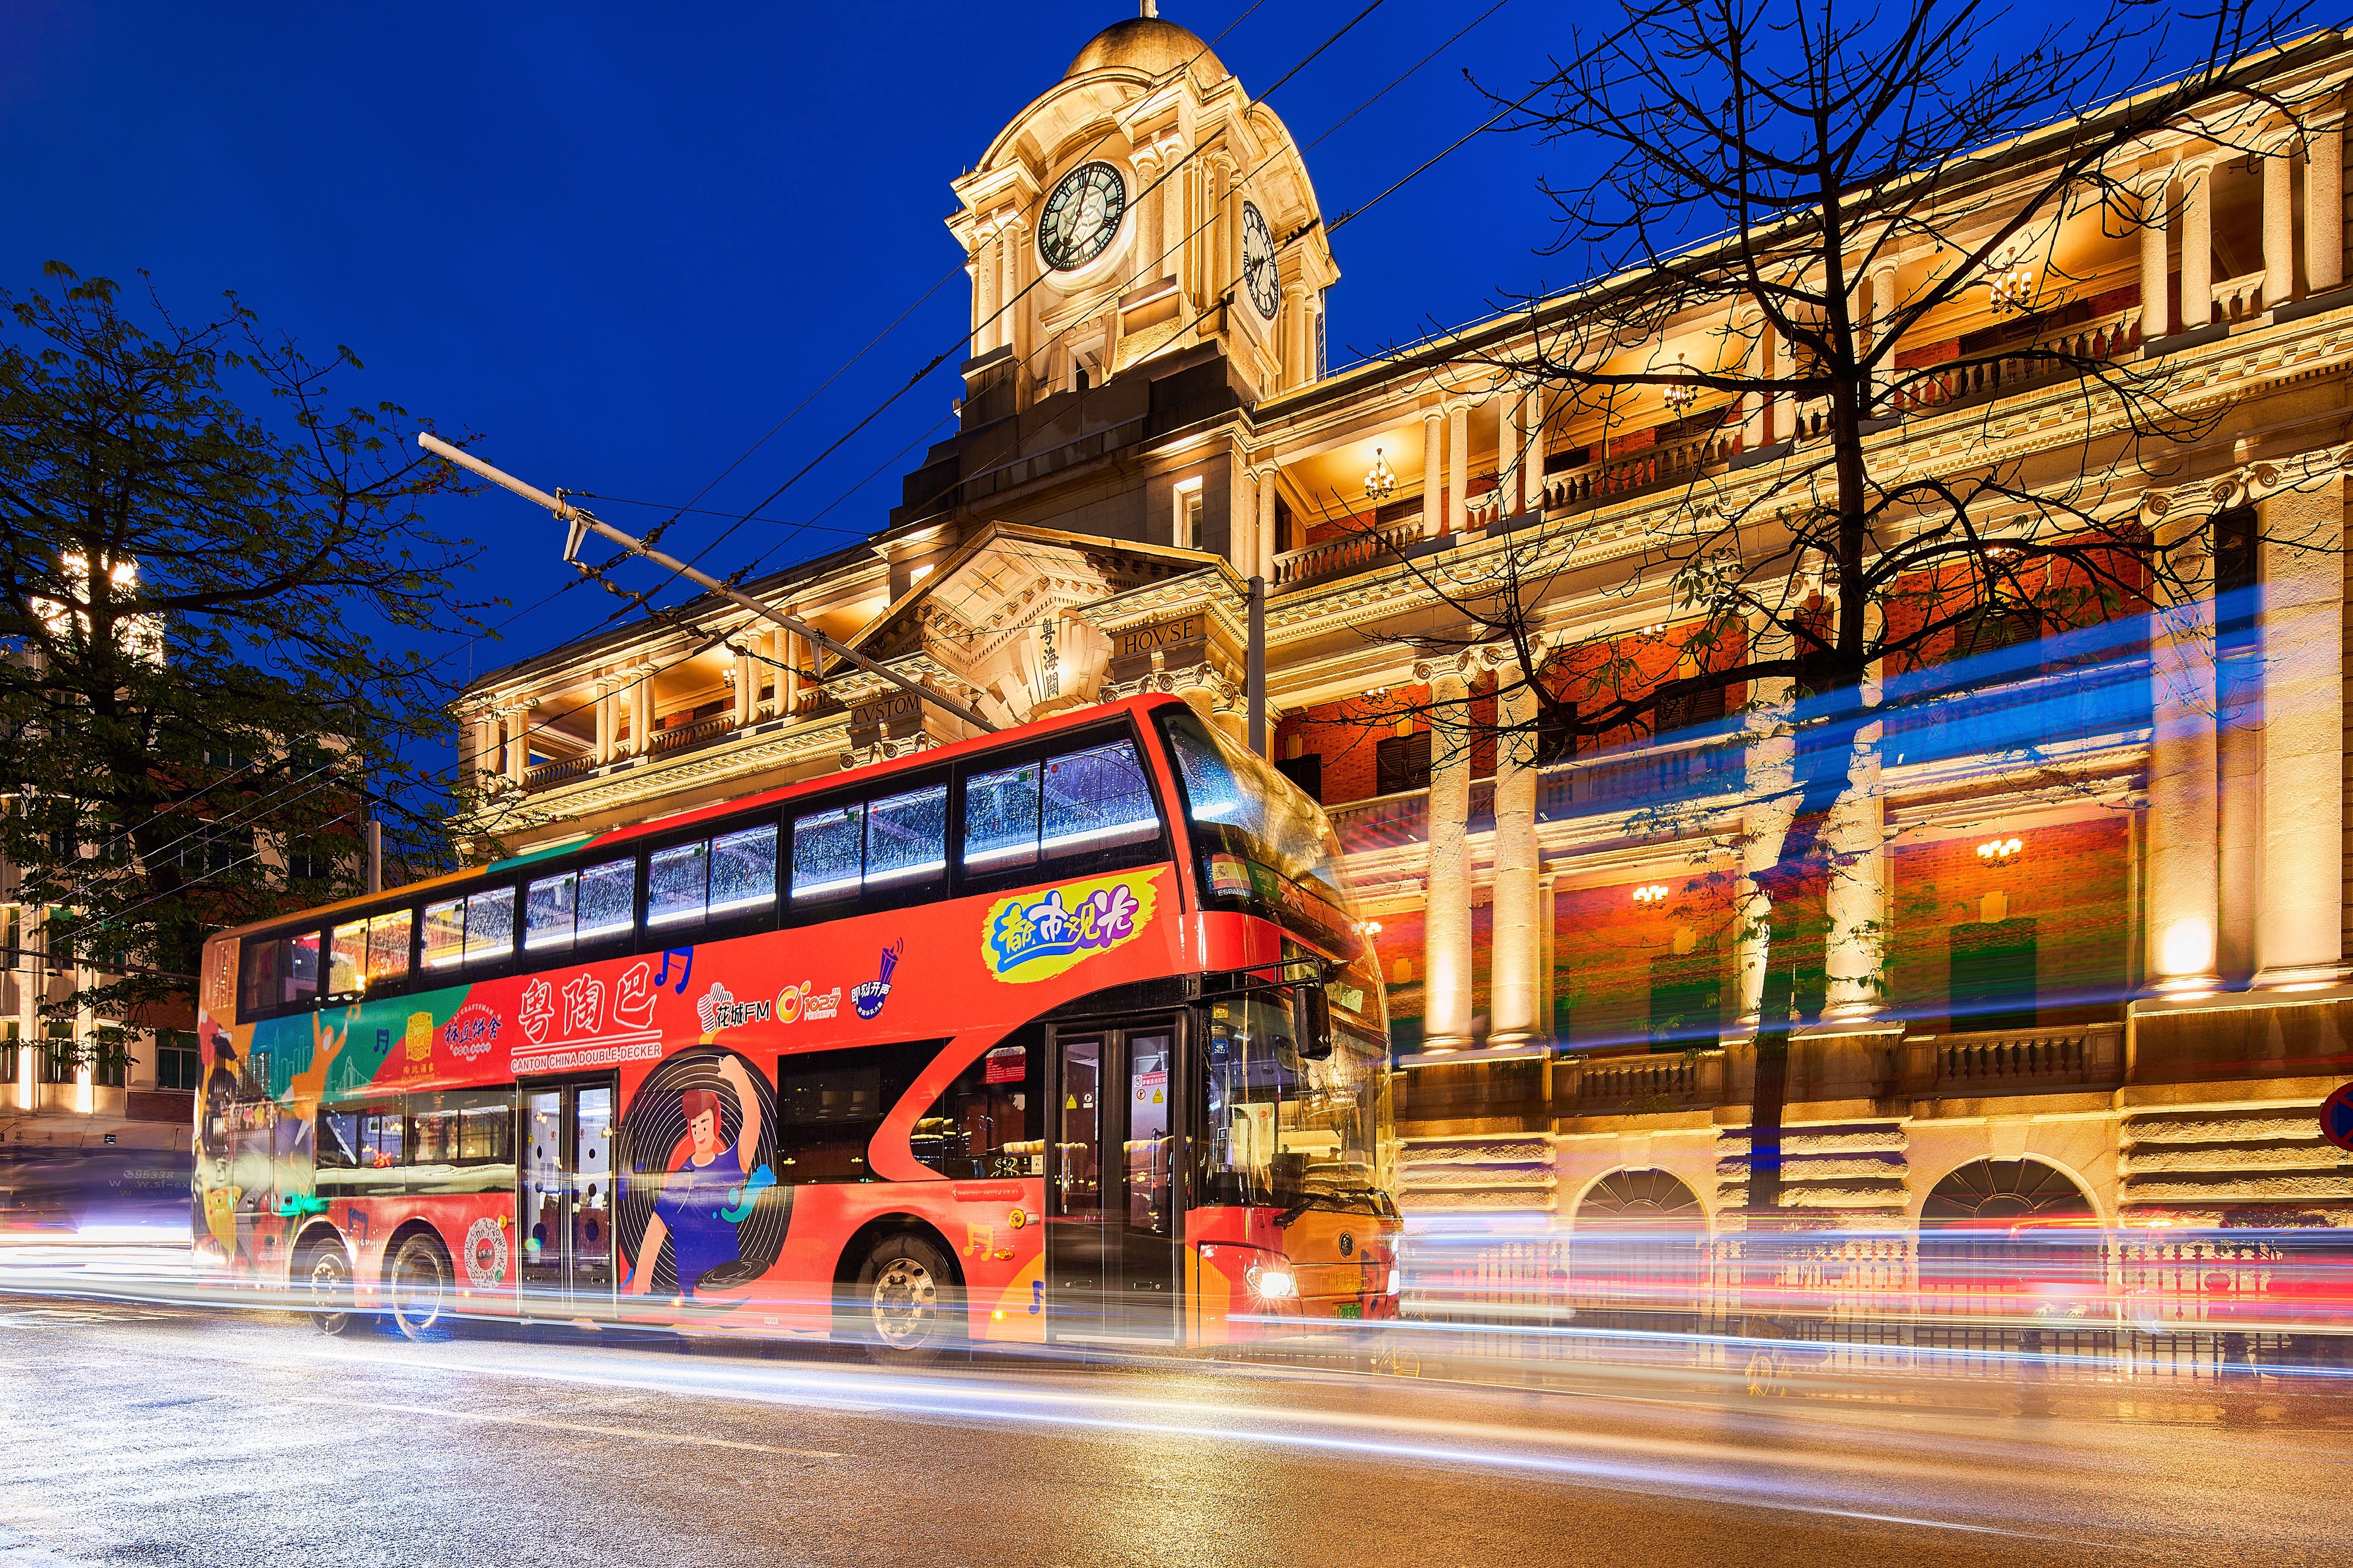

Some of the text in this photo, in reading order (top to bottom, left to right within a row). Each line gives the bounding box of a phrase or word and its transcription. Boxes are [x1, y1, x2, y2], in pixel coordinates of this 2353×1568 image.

[998, 886, 1138, 955] 都市观光
[851, 981, 892, 1005] 即刻开声
[717, 1001, 770, 1028] 花城FM
[511, 1043, 662, 1073] CANTON CHINA DOUBLE-DECKER
[134, 1171, 174, 1179] 95338
[1320, 1271, 1368, 1293] 广州观光巴士
